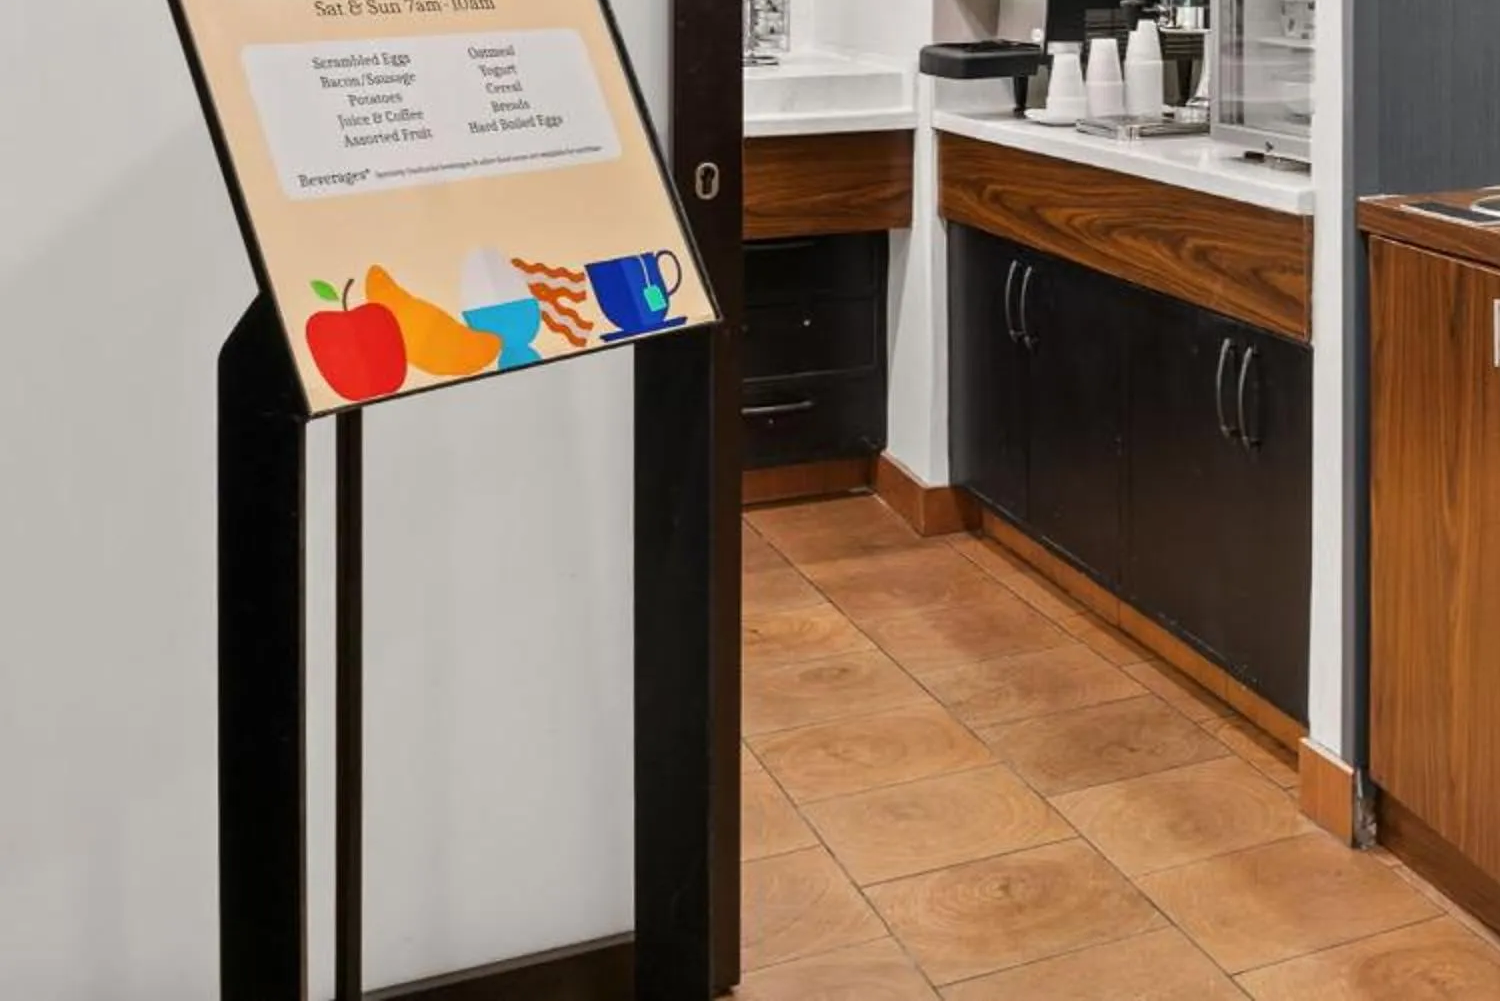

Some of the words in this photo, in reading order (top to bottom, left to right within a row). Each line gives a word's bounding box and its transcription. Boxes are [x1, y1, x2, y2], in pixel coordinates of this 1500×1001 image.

[313, 0, 344, 17] Sat
[349, 0, 364, 16] &
[312, 53, 380, 69] Scrambled
[381, 52, 411, 67] Eggs
[347, 92, 403, 107] Potatoes
[337, 114, 370, 130] Juice
[468, 119, 499, 133] Hard
[344, 129, 400, 148] Assorted
[401, 126, 433, 141] Fruit
